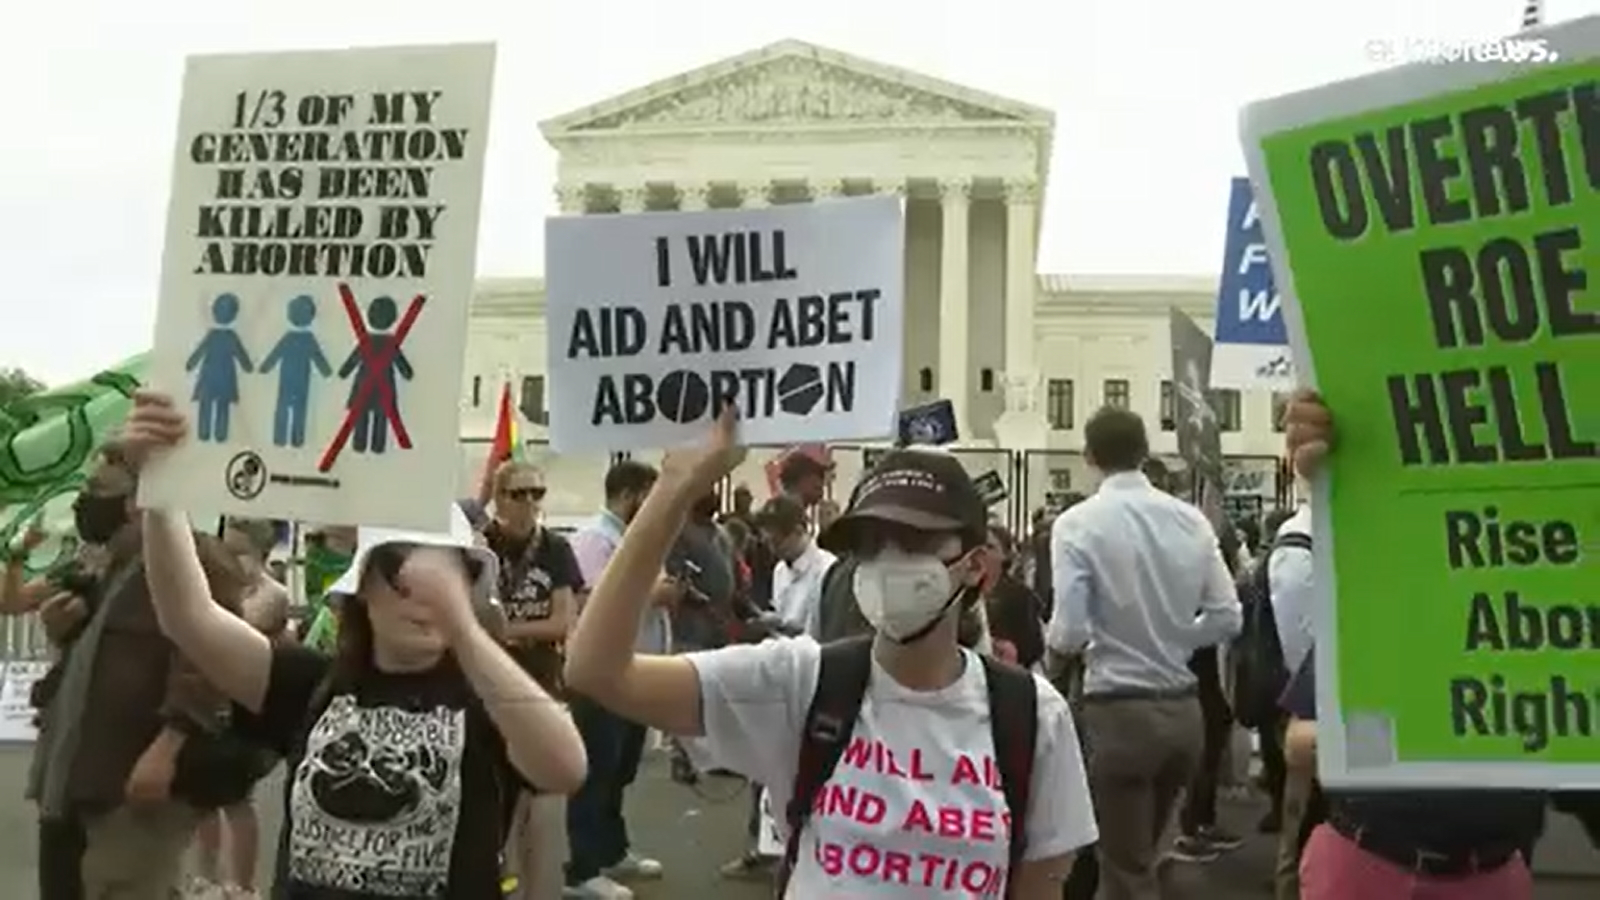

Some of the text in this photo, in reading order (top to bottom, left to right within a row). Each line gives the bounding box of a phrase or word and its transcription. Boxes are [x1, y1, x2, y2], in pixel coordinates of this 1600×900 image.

[232, 90, 443, 129] 1/3 OF MY
[190, 128, 468, 163] GENERATION
[214, 166, 434, 200] HAS BEEN
[194, 205, 446, 240] KILLED BY
[193, 242, 433, 279] ABORTION
[656, 229, 797, 287] I WILL
[1418, 225, 1600, 349] ROE
[567, 288, 881, 359] AID AND ABET
[591, 361, 856, 426] ABORTION
[1386, 360, 1597, 466] HELL
[1445, 505, 1579, 570] Rise
[1449, 672, 1600, 753] Righ
